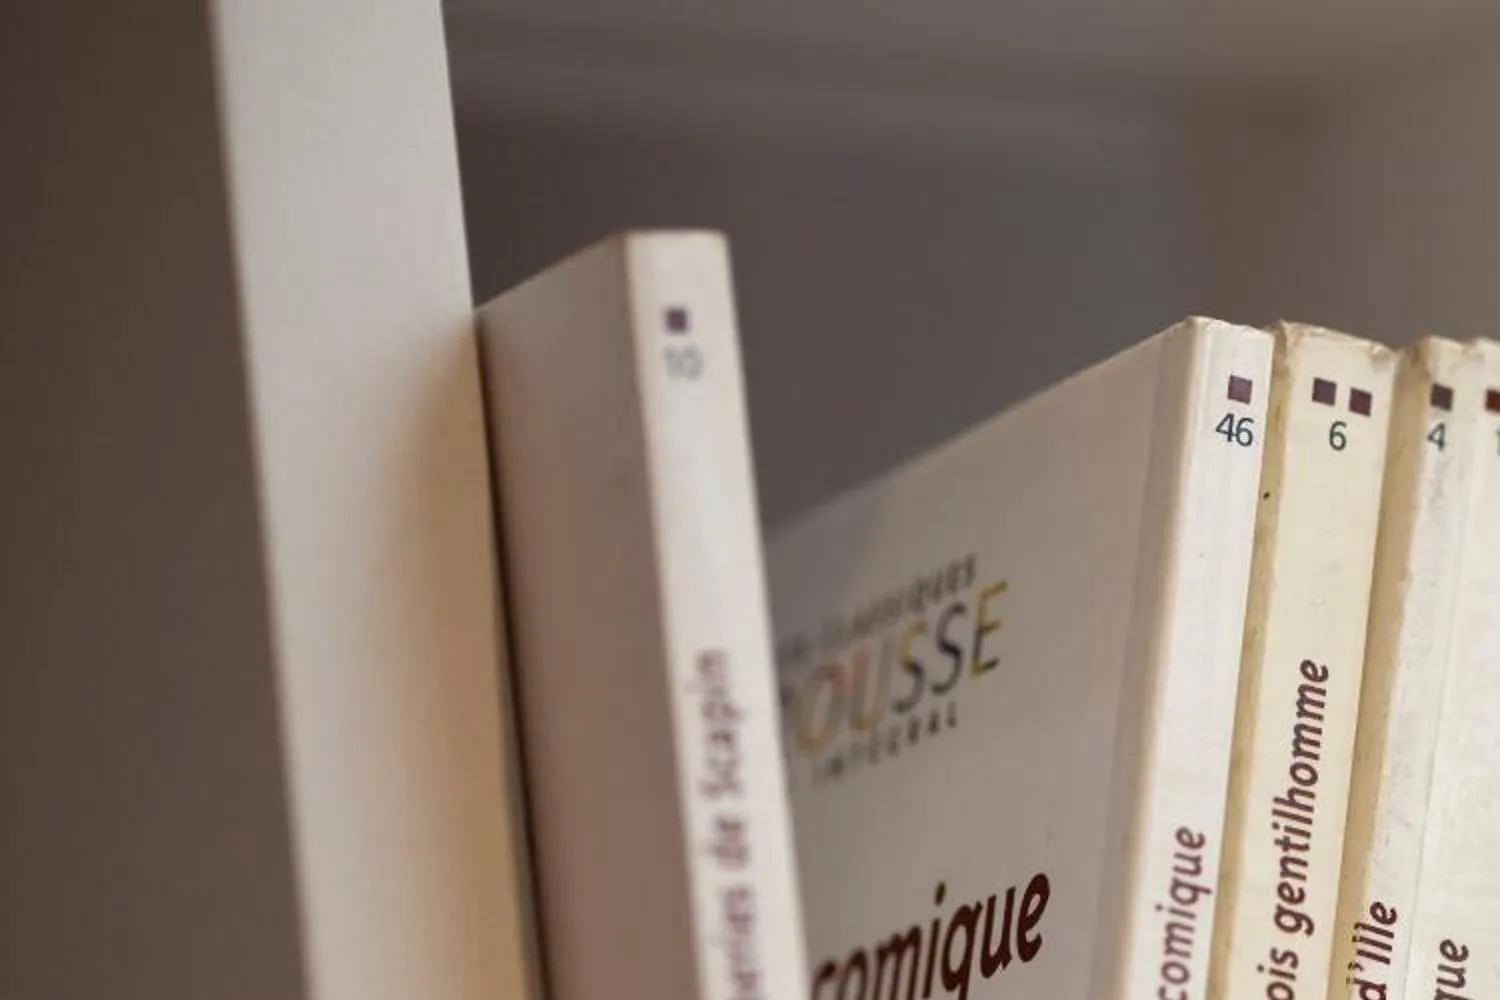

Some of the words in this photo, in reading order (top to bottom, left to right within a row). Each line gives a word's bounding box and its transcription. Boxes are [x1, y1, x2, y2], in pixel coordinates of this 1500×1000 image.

[1215, 412, 1254, 447] 46
[1328, 420, 1348, 451] 6
[1426, 422, 1447, 452] 4
[795, 579, 1009, 756] OUSSE
[1270, 658, 1330, 937] gentilhomme
